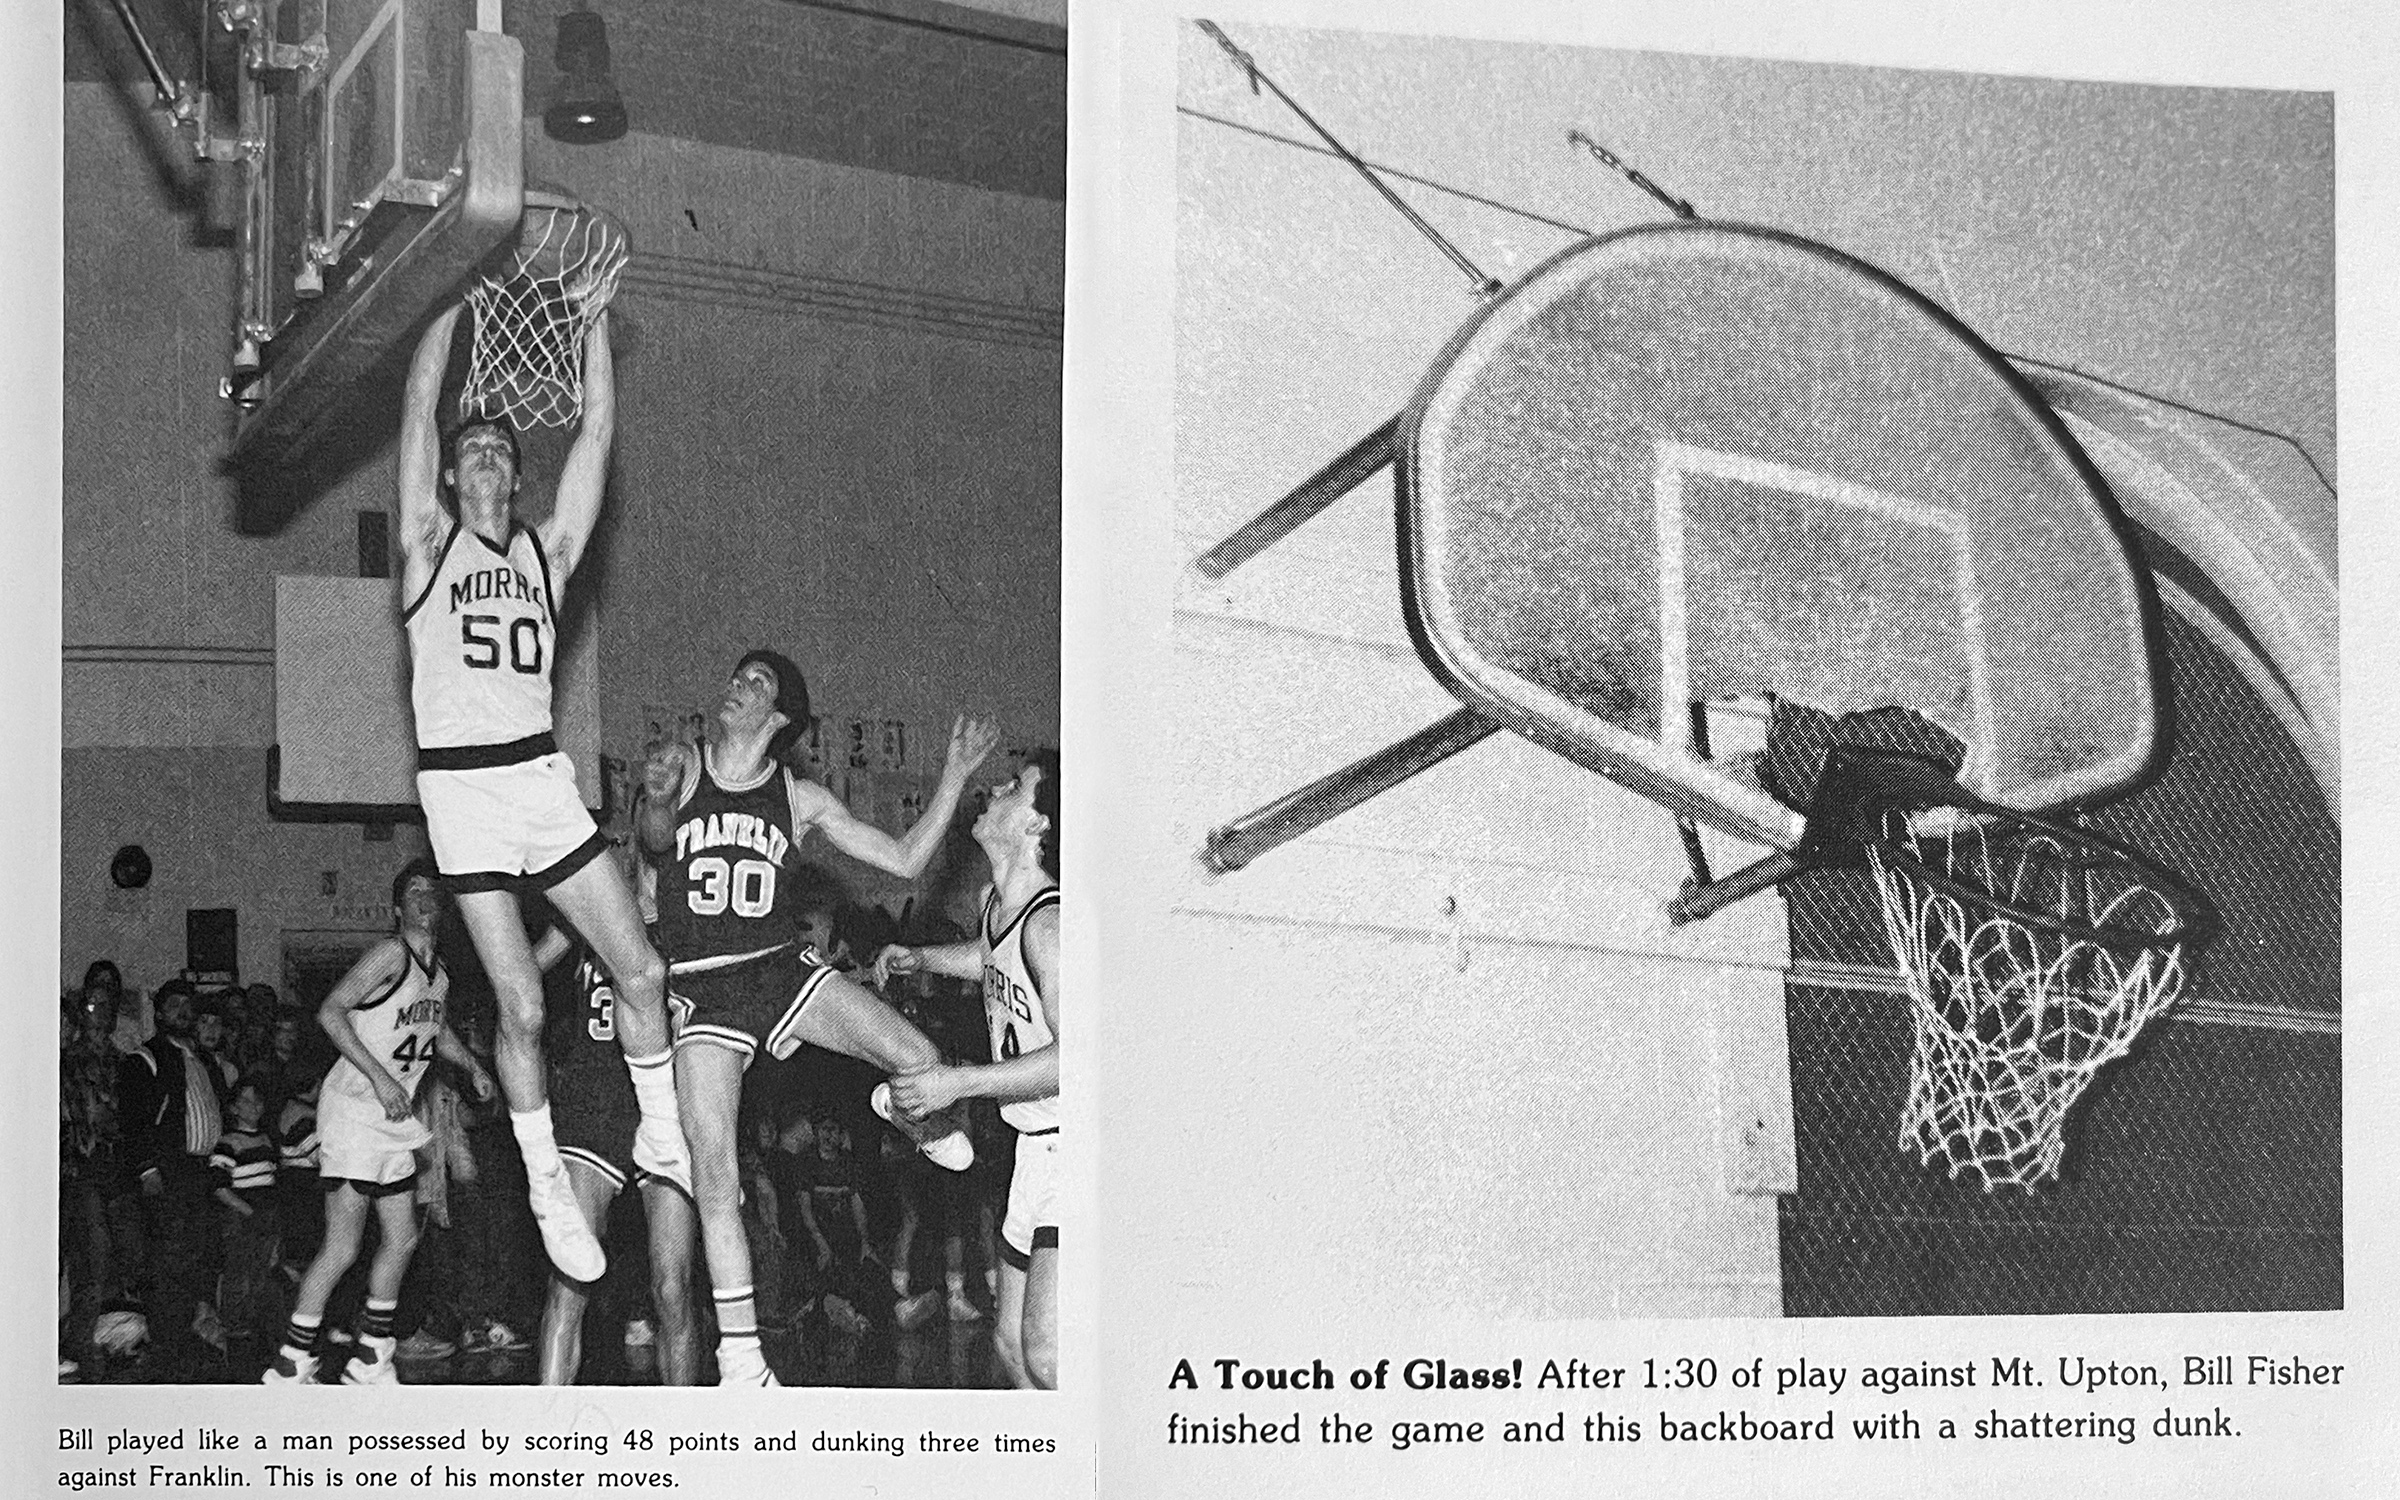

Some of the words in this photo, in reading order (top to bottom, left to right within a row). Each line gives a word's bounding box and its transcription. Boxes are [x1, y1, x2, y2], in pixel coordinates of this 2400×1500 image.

[462, 613, 542, 674] 50
[687, 857, 776, 918] 30
[1167, 1358, 1199, 1390] A
[1213, 1358, 1335, 1391] Touch
[1349, 1358, 1390, 1391] of
[1403, 1358, 1523, 1391] Glass!
[1537, 1358, 1626, 1389] After
[1643, 1357, 1718, 1389] 1:30
[1731, 1357, 1763, 1388] of
[1776, 1357, 1847, 1396] play
[1861, 1360, 1977, 1395] against
[1991, 1357, 2043, 1387] Mt.
[2058, 1356, 2168, 1394] Upton,
[2183, 1355, 2233, 1386] Bill
[2247, 1355, 2345, 1386] Fisher
[58, 1427, 93, 1450] Bill
[107, 1427, 184, 1456] played
[198, 1427, 240, 1450] like
[254, 1435, 268, 1450] a
[282, 1435, 333, 1450] man
[348, 1428, 466, 1456] possessed
[481, 1428, 510, 1456] by
[524, 1431, 608, 1456] scoring
[622, 1429, 654, 1451] 48
[669, 1432, 740, 1456] points
[753, 1429, 797, 1452] and
[811, 1430, 905, 1457] dunking
[919, 1430, 979, 1453] three
[994, 1433, 1056, 1453] times
[1167, 1412, 1301, 1445] finished
[1319, 1412, 1373, 1444] the
[1391, 1422, 1484, 1451] game
[1503, 1411, 1565, 1443] and
[1583, 1411, 1641, 1443] this
[1659, 1409, 1834, 1442] backboard
[1852, 1409, 1921, 1440] with
[1938, 1419, 1957, 1440] a
[1974, 1408, 2136, 1445] shattering
[2152, 1406, 2241, 1438] dunk.
[57, 1467, 137, 1492] against
[149, 1464, 251, 1487] Franklin.
[264, 1464, 314, 1487] This
[326, 1467, 344, 1487] is
[355, 1471, 398, 1487] one
[410, 1464, 433, 1487] of
[445, 1465, 477, 1488] his
[489, 1468, 585, 1488] monster
[597, 1472, 679, 1488] moves.
